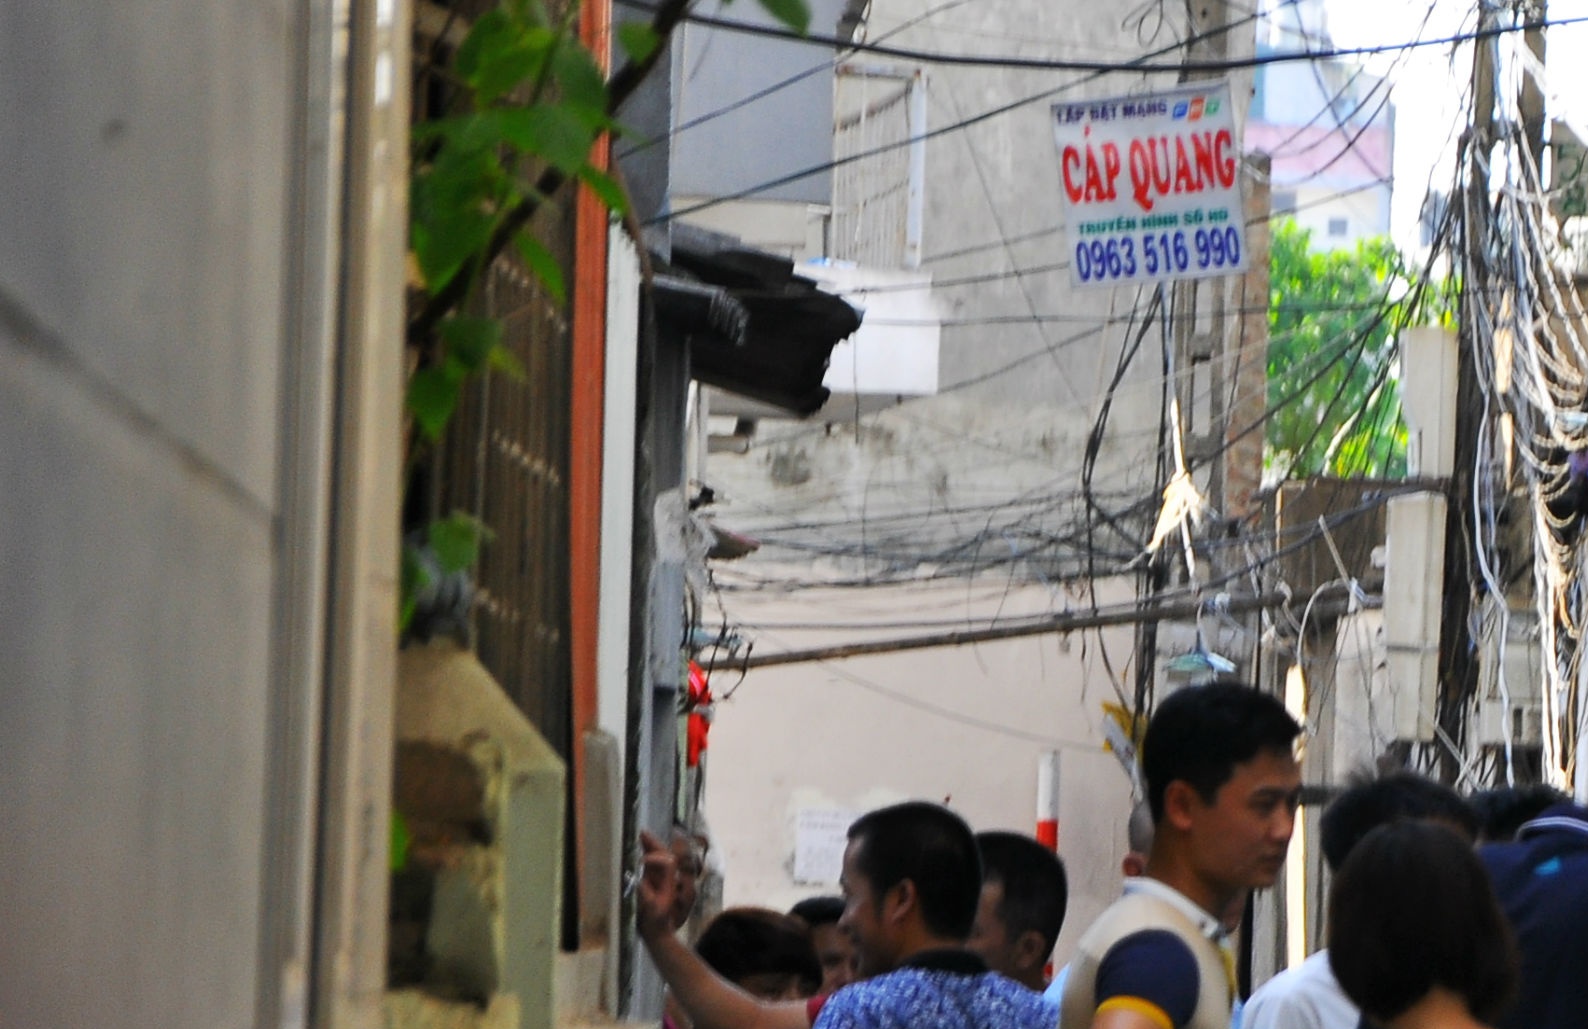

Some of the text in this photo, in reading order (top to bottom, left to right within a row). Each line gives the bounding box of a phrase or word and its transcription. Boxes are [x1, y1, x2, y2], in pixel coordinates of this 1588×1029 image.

[1062, 125, 1235, 212] CÁP QUANG
[1076, 226, 1240, 282] 0963 516 990
